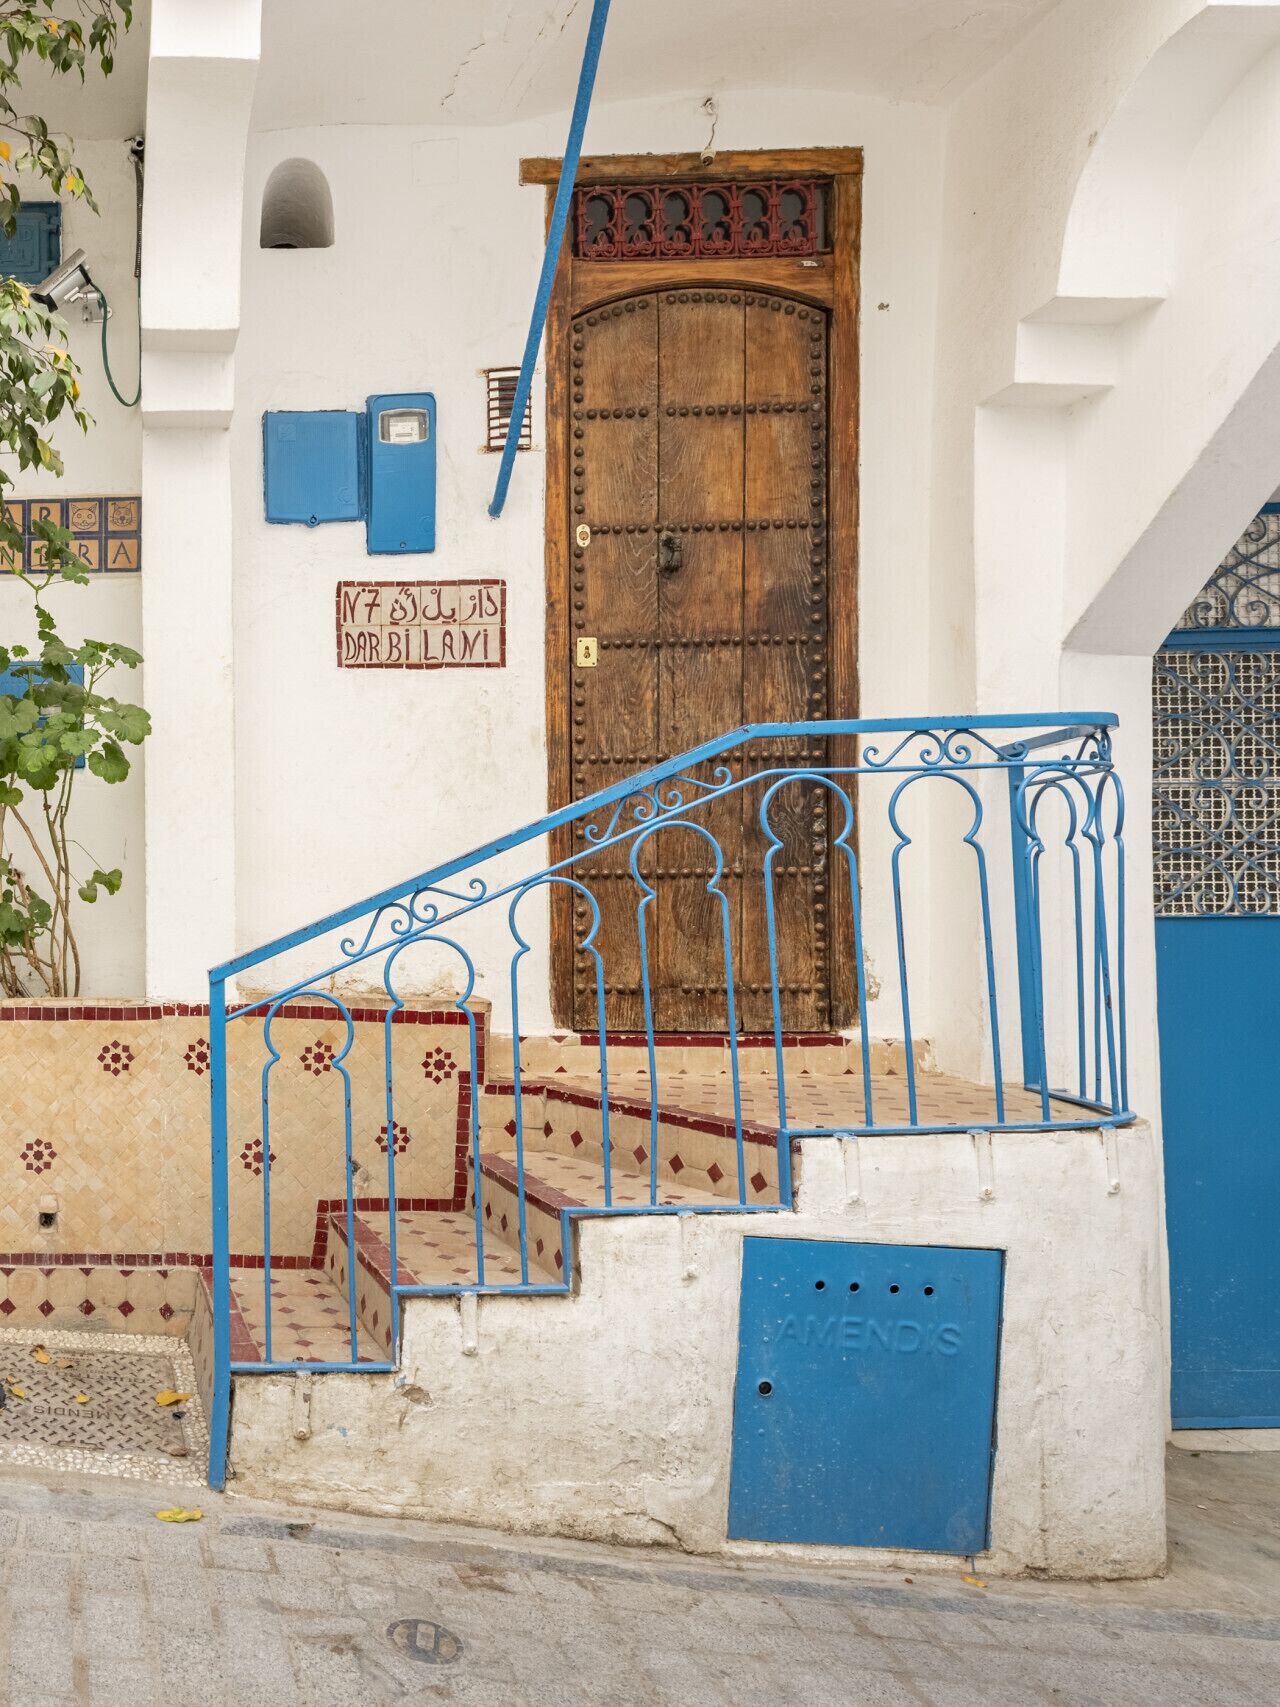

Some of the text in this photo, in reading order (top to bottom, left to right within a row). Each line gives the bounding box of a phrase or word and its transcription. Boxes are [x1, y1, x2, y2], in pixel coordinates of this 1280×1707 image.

[345, 630, 381, 663] DAR
[776, 1314, 962, 1356] AMENDIS
[34, 1405, 127, 1421] AMENDIS
